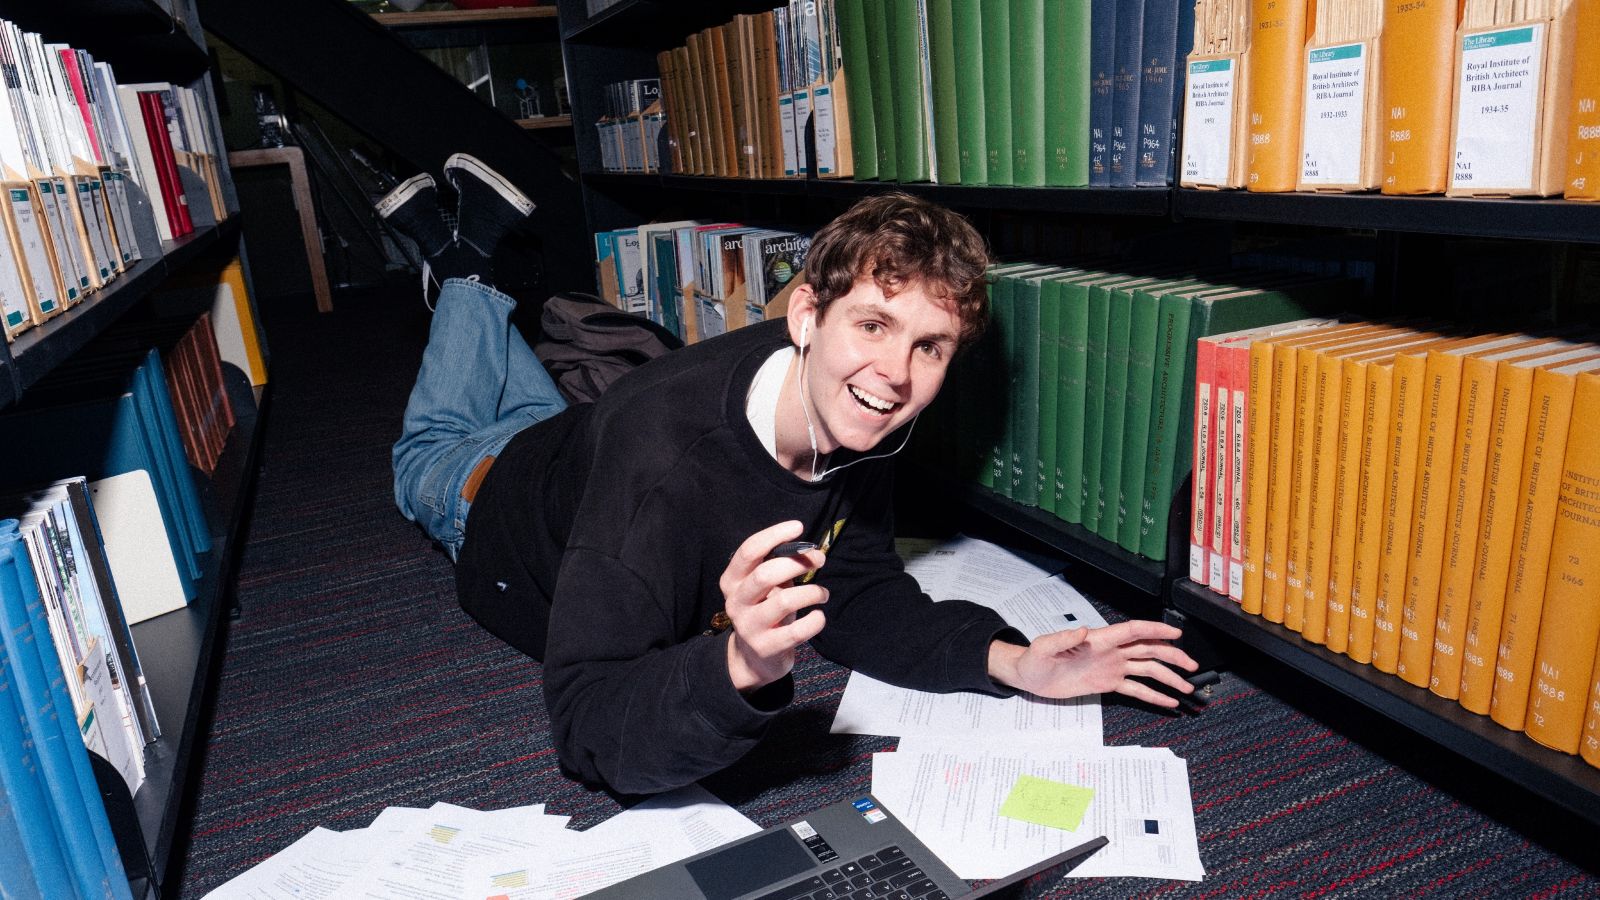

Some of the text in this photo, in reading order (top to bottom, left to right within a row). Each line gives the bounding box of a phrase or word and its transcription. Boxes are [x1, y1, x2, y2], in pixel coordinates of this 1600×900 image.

[1464, 35, 1497, 46] The Library
[1312, 69, 1360, 82] Royal Institute of
[1466, 55, 1531, 73] Royal Institute of
[1466, 70, 1529, 82] British Architects
[644, 85, 659, 95] Lo
[1312, 80, 1359, 91] British Architects
[1316, 90, 1354, 100] RIBA Journal
[1471, 81, 1522, 93] RIBA Journal
[1391, 107, 1406, 119] NA1
[1481, 104, 1509, 114] 1934-35
[1456, 151, 1462, 159] P
[1575, 151, 1583, 165] J
[1454, 173, 1473, 181] R888
[1157, 313, 1175, 431] PROGRESSIVE ARCHITECTURE
[1367, 381, 1376, 421] INSTITUTE
[1397, 376, 1407, 419] INSTITUTE
[1431, 375, 1442, 418] INSTITUTE
[1466, 380, 1479, 425] INSTITUTE
[1497, 388, 1511, 434] INSTITUTE
[1536, 395, 1550, 442] INSTITUTE
[1364, 437, 1373, 467] BRITISH
[1393, 436, 1402, 467] BRITISH
[1425, 436, 1435, 468] BRITISH
[1460, 443, 1471, 475] BRITISH
[1490, 452, 1501, 485] BRITISH
[1529, 461, 1541, 496] BRITISH
[1360, 470, 1370, 517] ARCHITECTS
[1389, 469, 1399, 518] ARCHITECTS
[1419, 470, 1432, 519] ARCHITECTS
[1561, 482, 1571, 491] OF
[1454, 478, 1466, 528] ARCHITECTS
[1484, 488, 1496, 540] ARCHITECTS
[1386, 520, 1395, 556] JOURNAL
[1415, 521, 1425, 559] JOURNAL
[1520, 499, 1534, 552] ARCHITECTS
[1449, 531, 1460, 569] JOURNAL
[1479, 542, 1489, 581] JOURNAL
[1514, 554, 1525, 593] JOURNAL
[1541, 661, 1559, 680] NA1
[1534, 697, 1541, 708] J
[1538, 677, 1565, 702] R888
[1534, 712, 1545, 727] 72
[1586, 735, 1598, 750] 73
